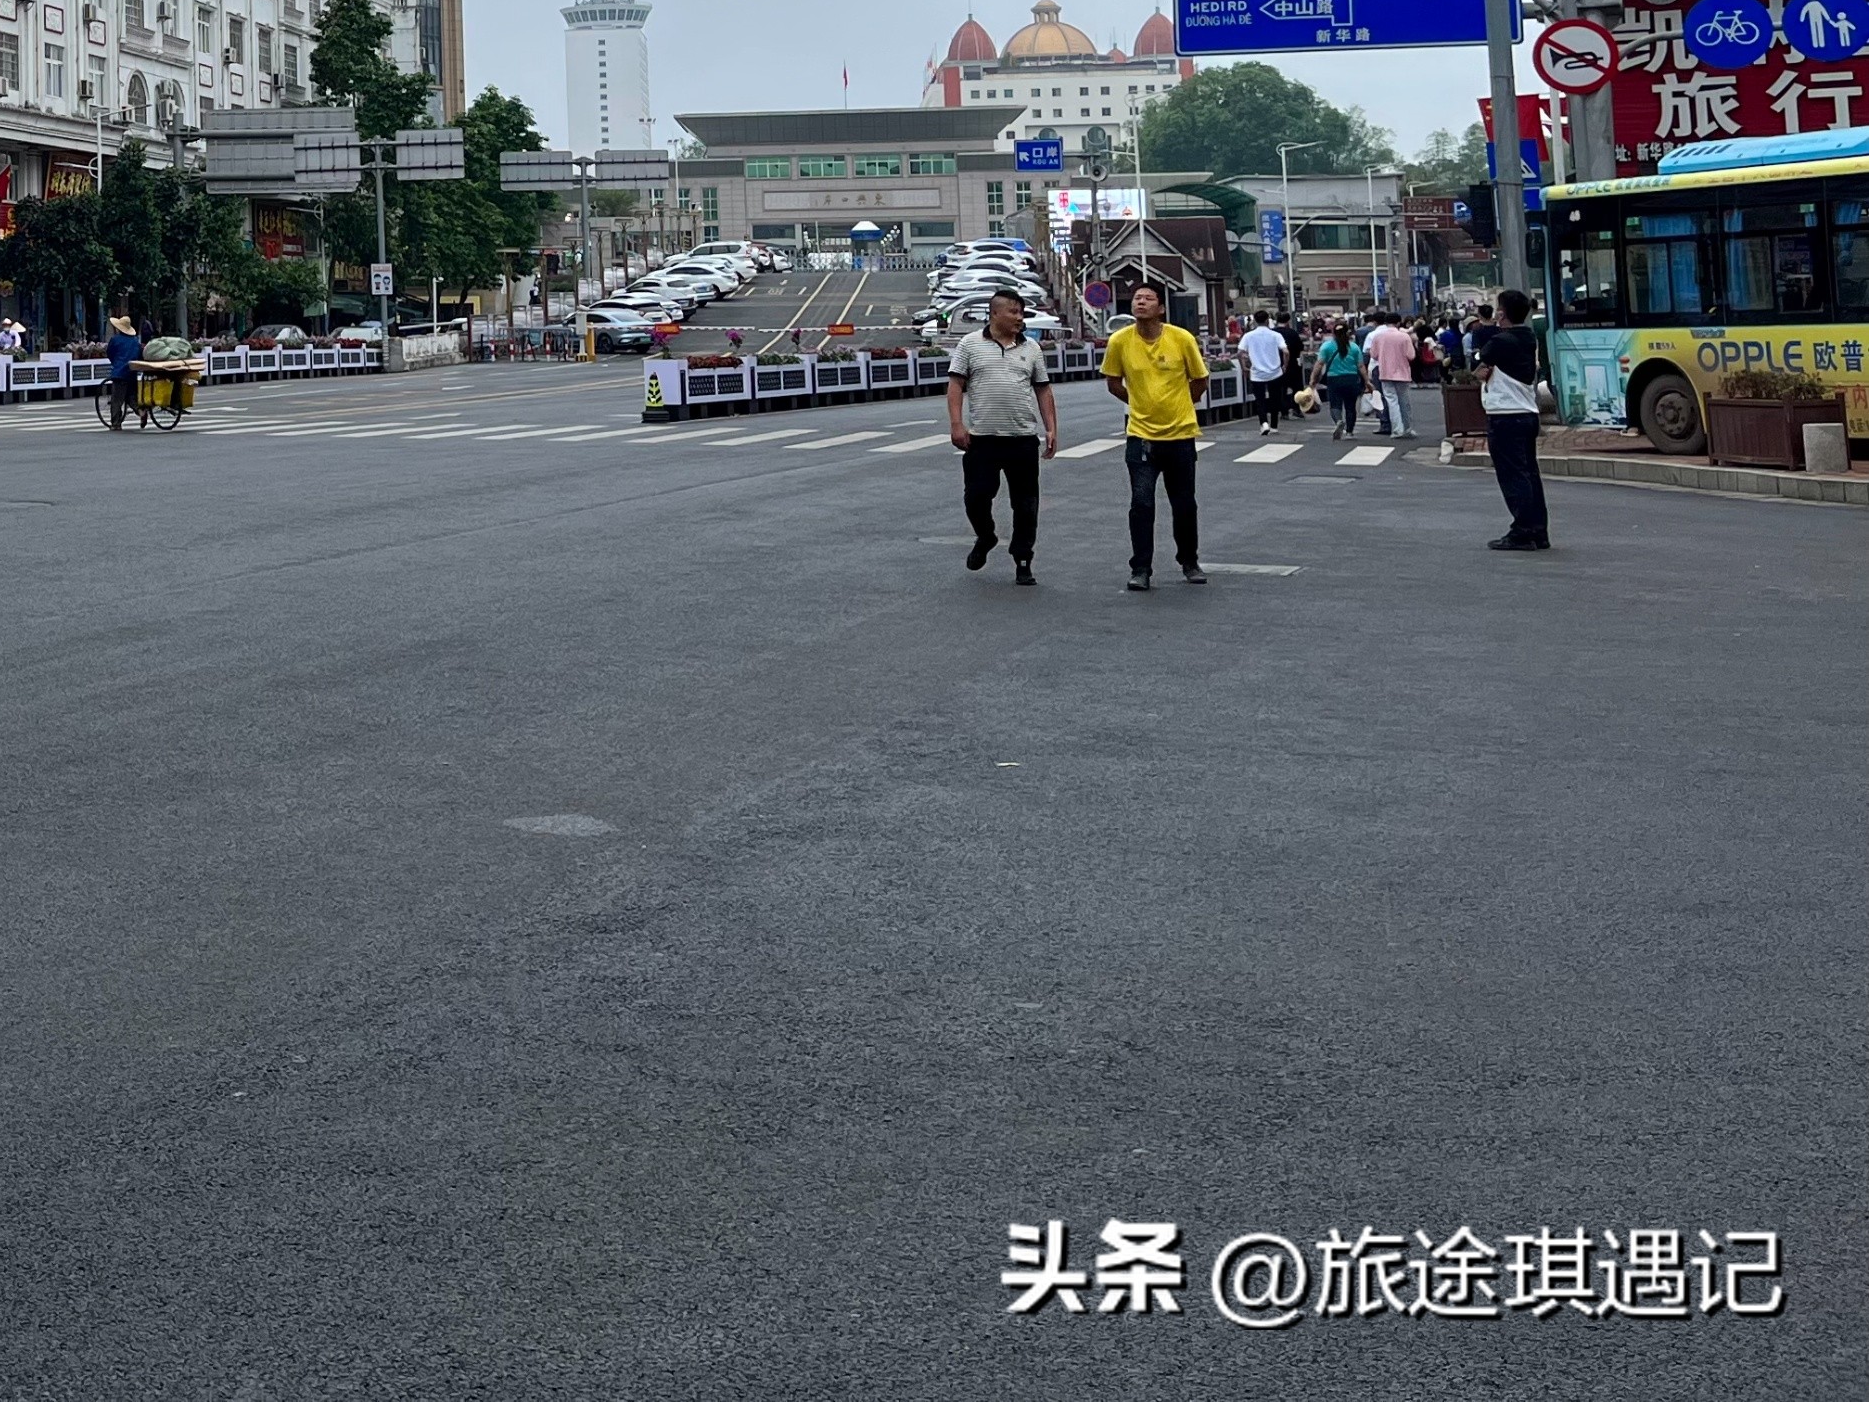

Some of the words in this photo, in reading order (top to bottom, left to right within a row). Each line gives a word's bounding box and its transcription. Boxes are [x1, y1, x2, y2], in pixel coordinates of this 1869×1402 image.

[1316, 27, 1371, 44] 新华路
[1032, 146, 1059, 158] 口岸
[1697, 340, 1805, 373] OPPLE
[1813, 339, 1865, 373] 欧普
